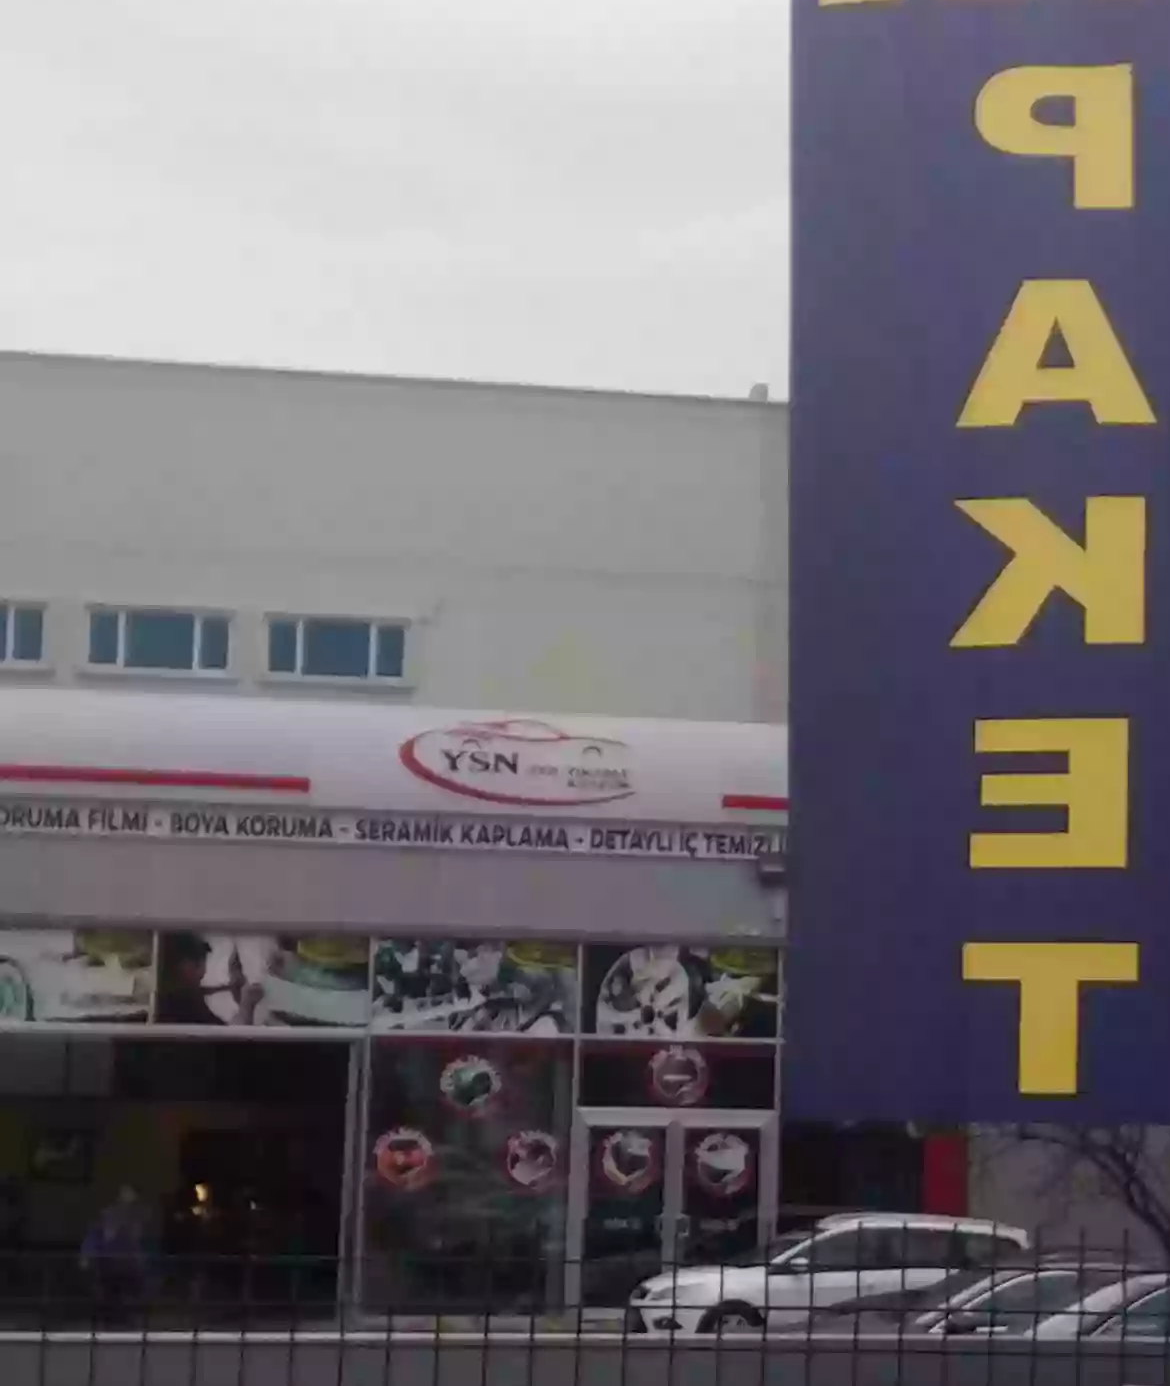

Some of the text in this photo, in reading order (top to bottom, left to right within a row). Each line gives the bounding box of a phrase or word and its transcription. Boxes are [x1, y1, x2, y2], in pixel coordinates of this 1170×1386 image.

[441, 749, 519, 775] YSN
[170, 812, 229, 835] BOYA
[236, 815, 333, 838] KORUMA
[460, 823, 569, 850] KAPLAMA
